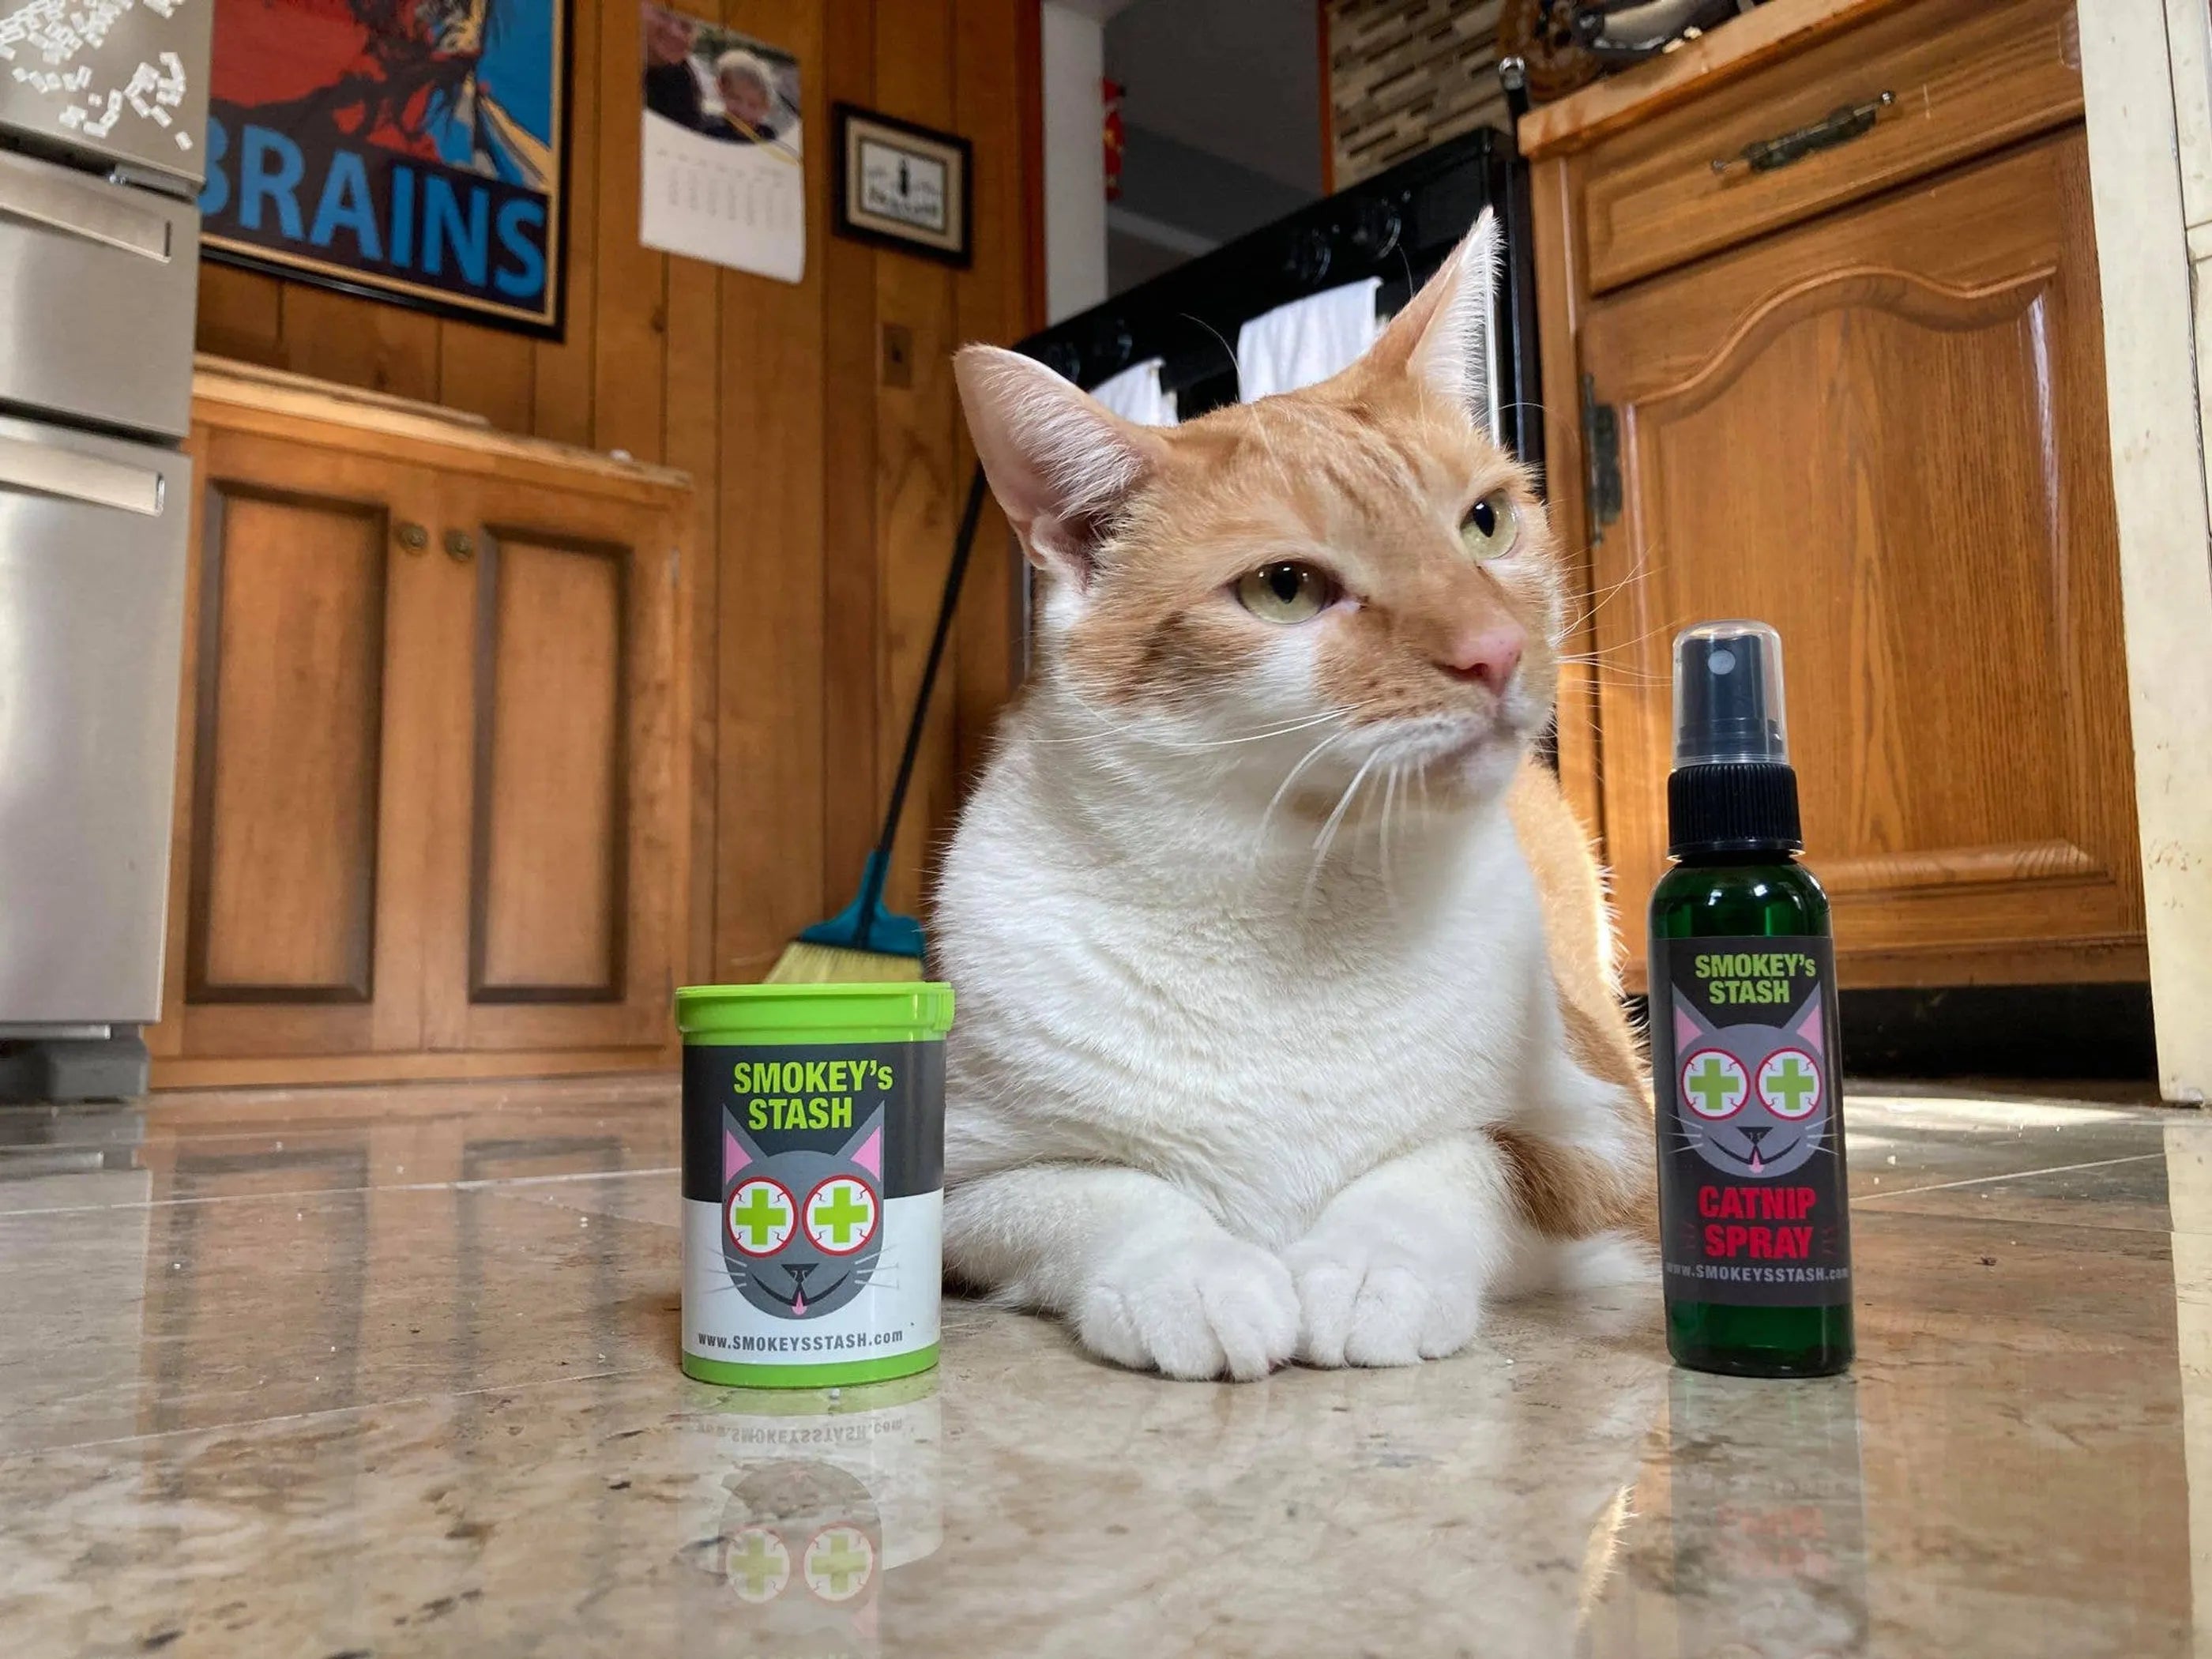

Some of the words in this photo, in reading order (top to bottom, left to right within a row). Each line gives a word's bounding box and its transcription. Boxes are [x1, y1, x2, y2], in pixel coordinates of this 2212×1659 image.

[1695, 954, 1816, 978] SMOKEY's
[1709, 980, 1790, 1004] STASH
[733, 1059, 893, 1094] SMOKEY's
[748, 1097, 852, 1130] STASH
[1698, 1186, 1816, 1219] CATNIP
[1704, 1224, 1814, 1258] SPRAY
[698, 1330, 903, 1352] www.SMOKEYSSTASH.com
